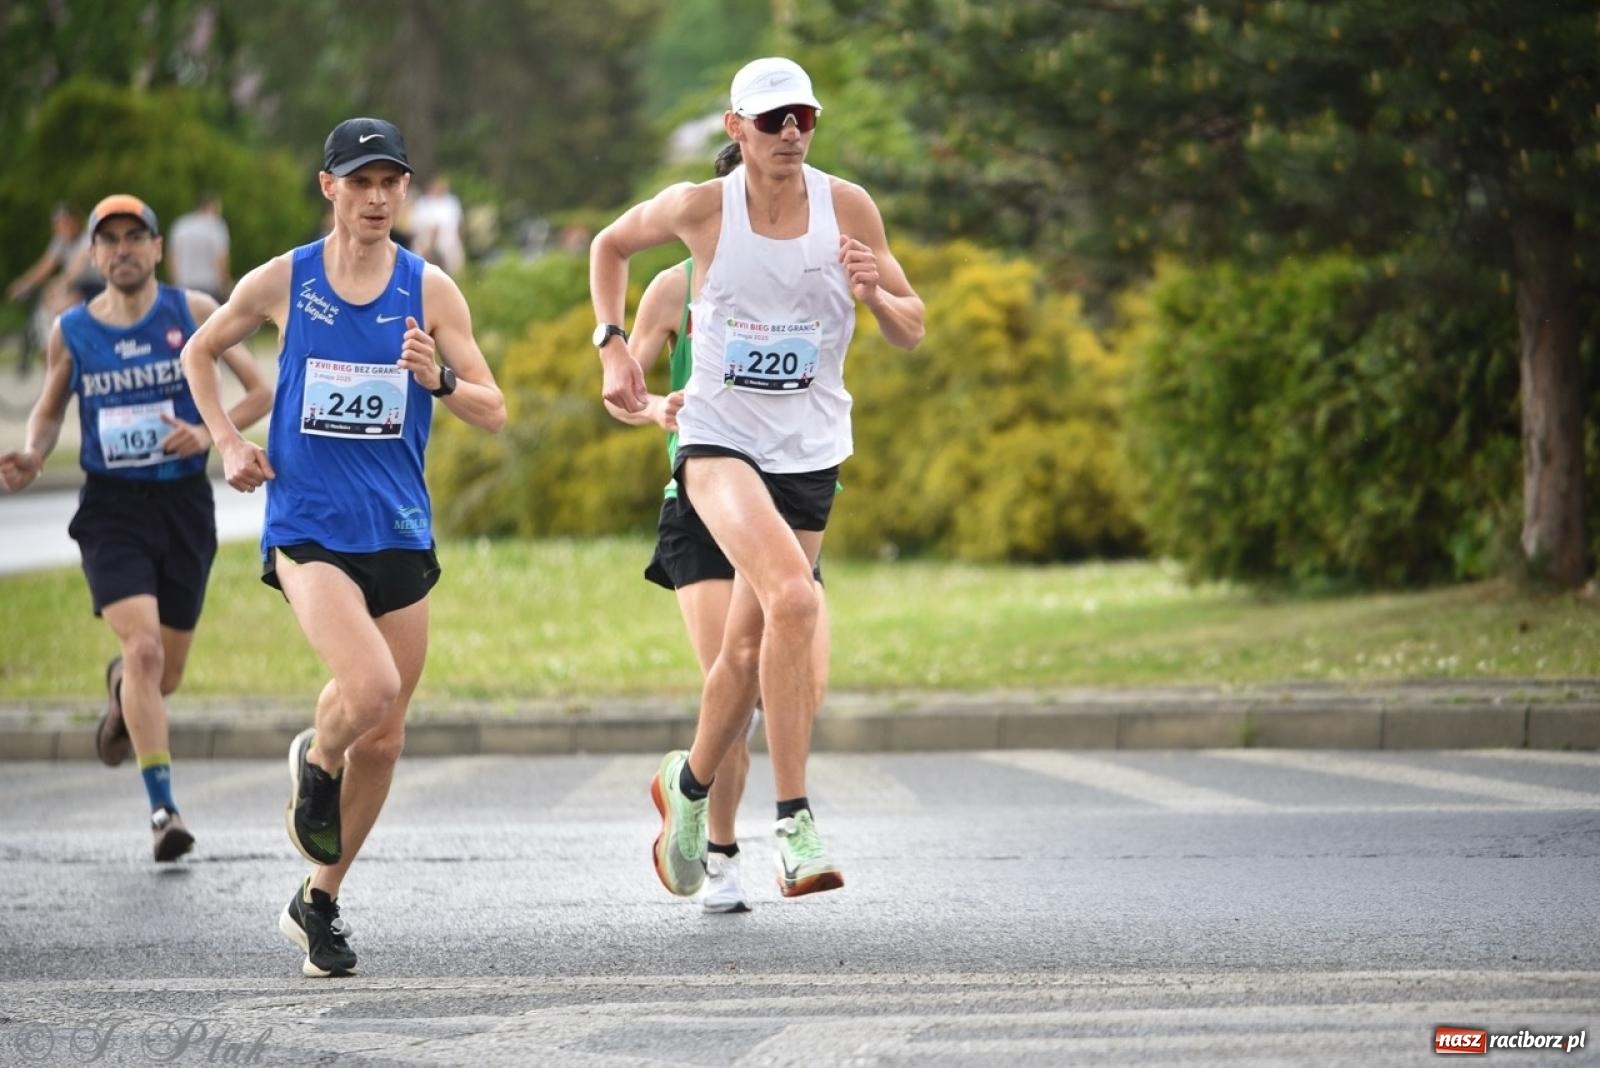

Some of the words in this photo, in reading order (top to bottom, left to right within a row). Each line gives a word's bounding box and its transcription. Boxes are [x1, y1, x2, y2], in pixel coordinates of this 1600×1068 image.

[750, 323, 769, 332] BIEG
[771, 324, 786, 333] BEZ
[314, 361, 331, 370] XVII
[333, 363, 353, 373] BIEG
[354, 365, 370, 374] BEZ
[747, 350, 799, 376] 220
[327, 392, 384, 420] 249
[120, 429, 159, 450] 163
